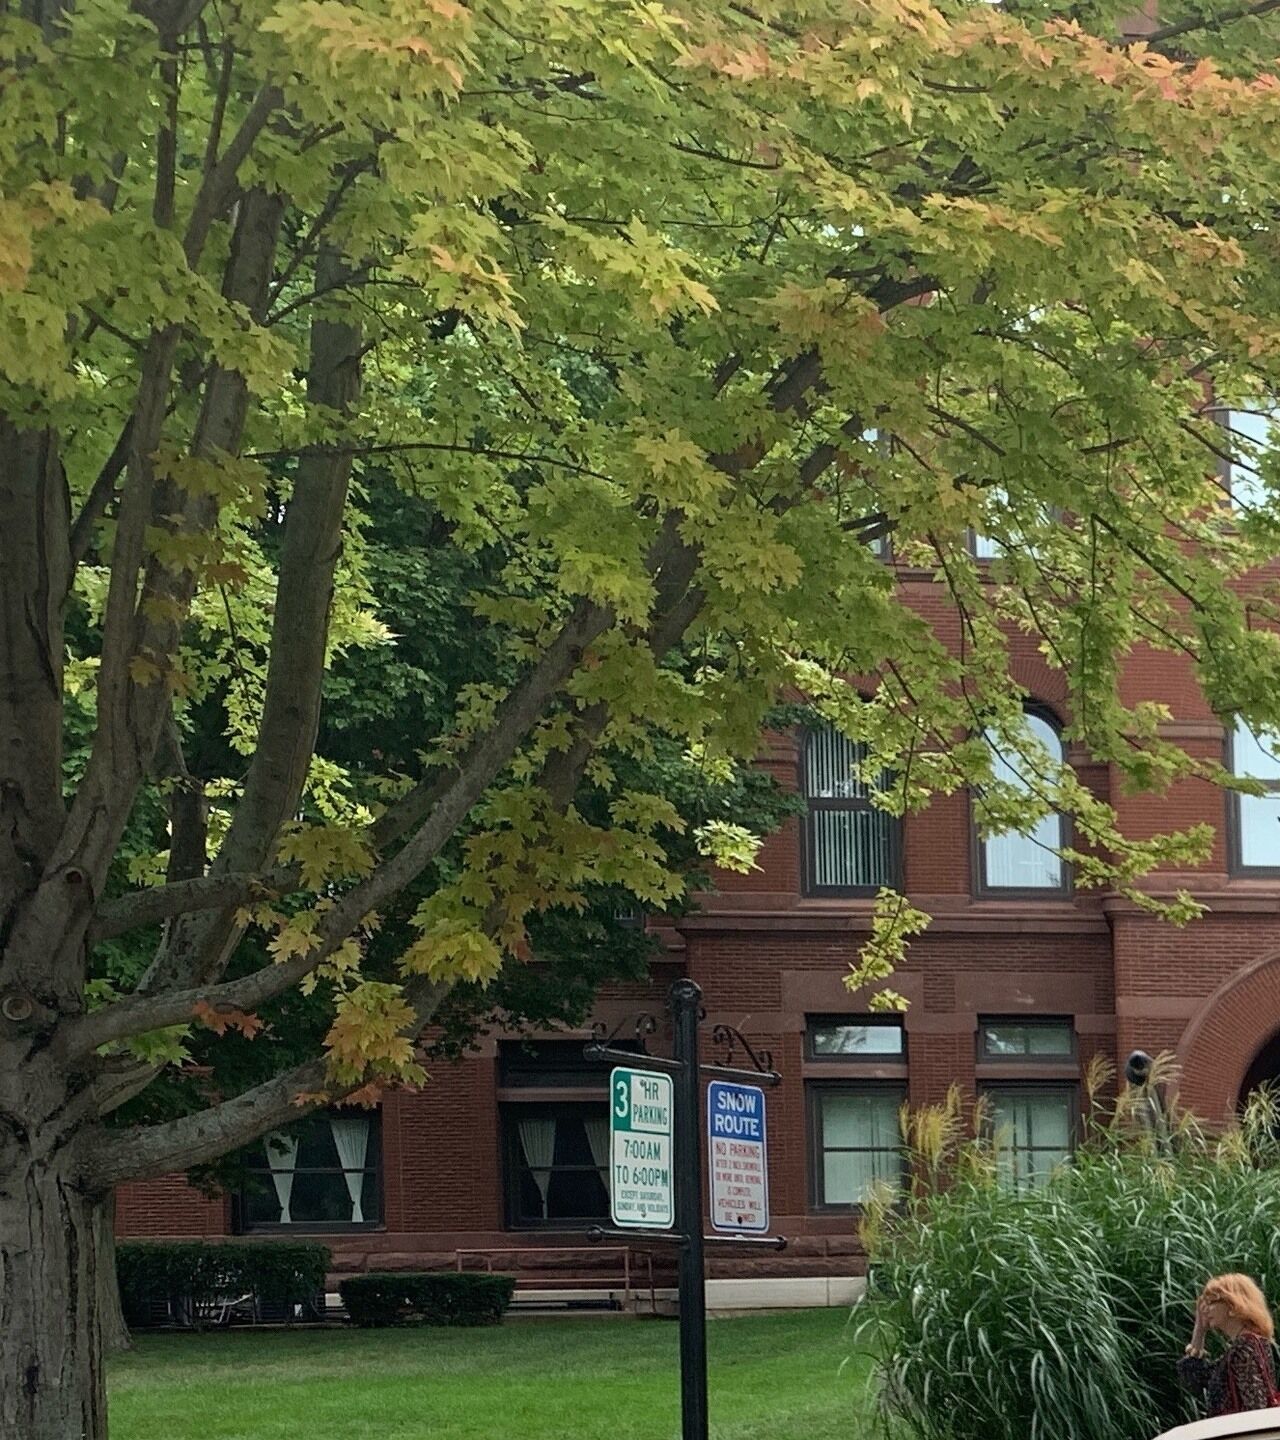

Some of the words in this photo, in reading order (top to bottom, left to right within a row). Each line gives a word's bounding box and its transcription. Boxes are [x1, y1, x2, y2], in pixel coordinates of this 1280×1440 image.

[615, 1080, 628, 1118] 3
[644, 1082, 659, 1100] HR
[717, 1090, 756, 1113] SNOW
[633, 1103, 668, 1126] PARKING
[714, 1113, 760, 1137] ROUTE
[624, 1139, 661, 1161] 7:00AM
[715, 1142, 727, 1155] NO
[616, 1165, 629, 1184] TO
[633, 1166, 669, 1188] 6:00PM
